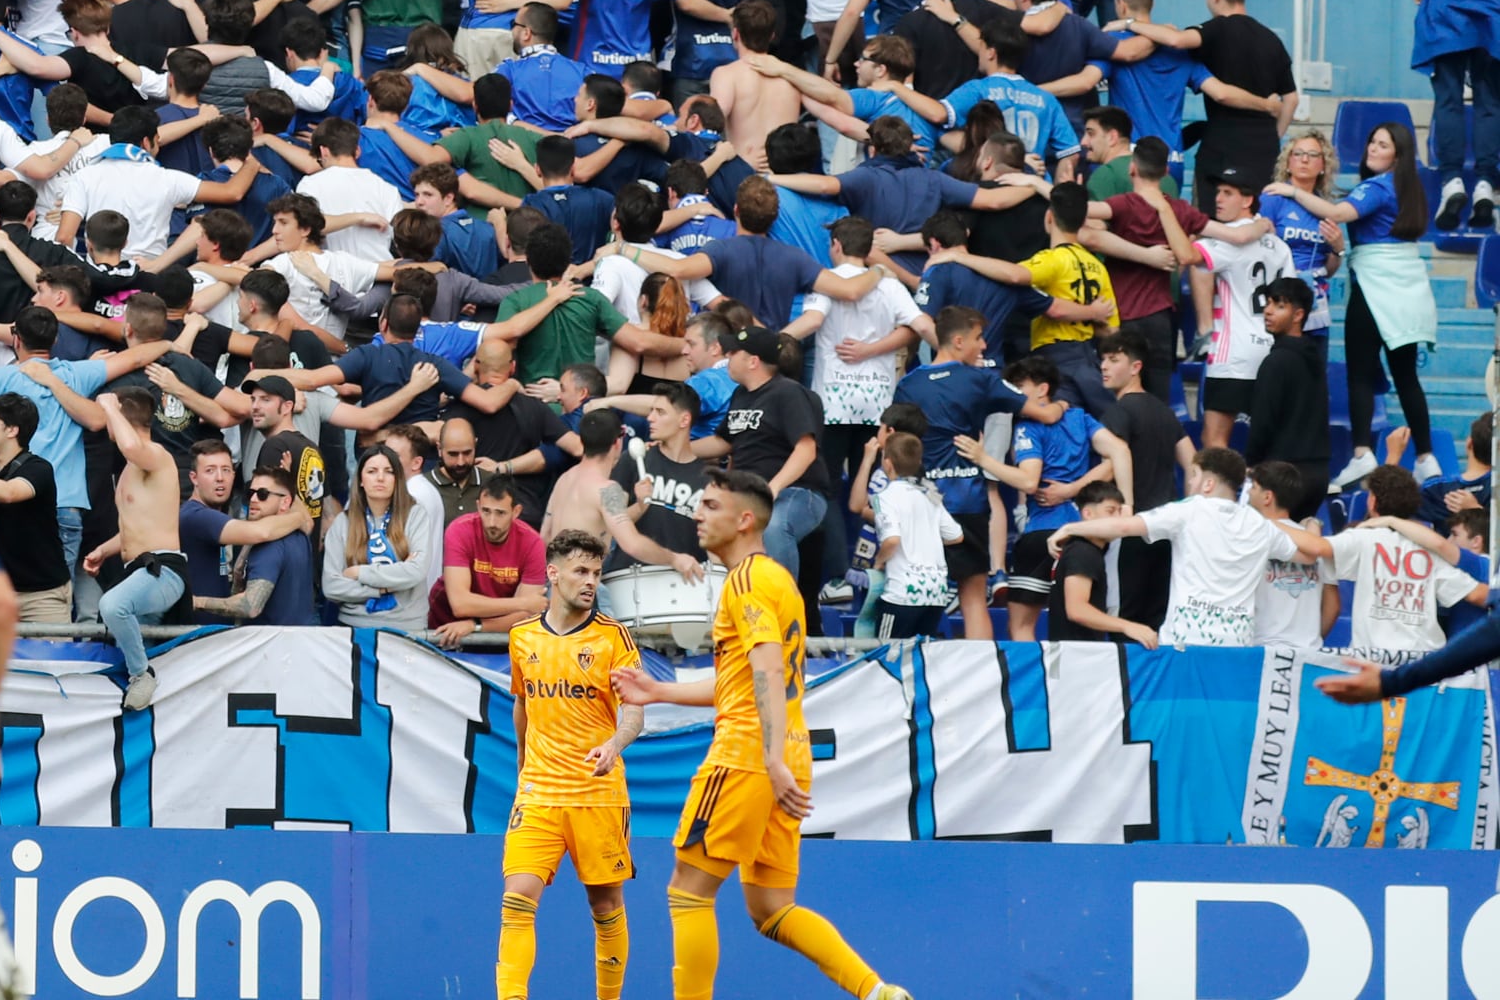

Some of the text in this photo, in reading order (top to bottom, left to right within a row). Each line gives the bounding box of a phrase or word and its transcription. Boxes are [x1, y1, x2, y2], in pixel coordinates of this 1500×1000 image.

[1002, 105, 1040, 153] 10
[1373, 542, 1434, 581] NO
[537, 679, 598, 699] tvitec
[1269, 648, 1298, 716] LEAL
[1257, 719, 1288, 784] MUY
